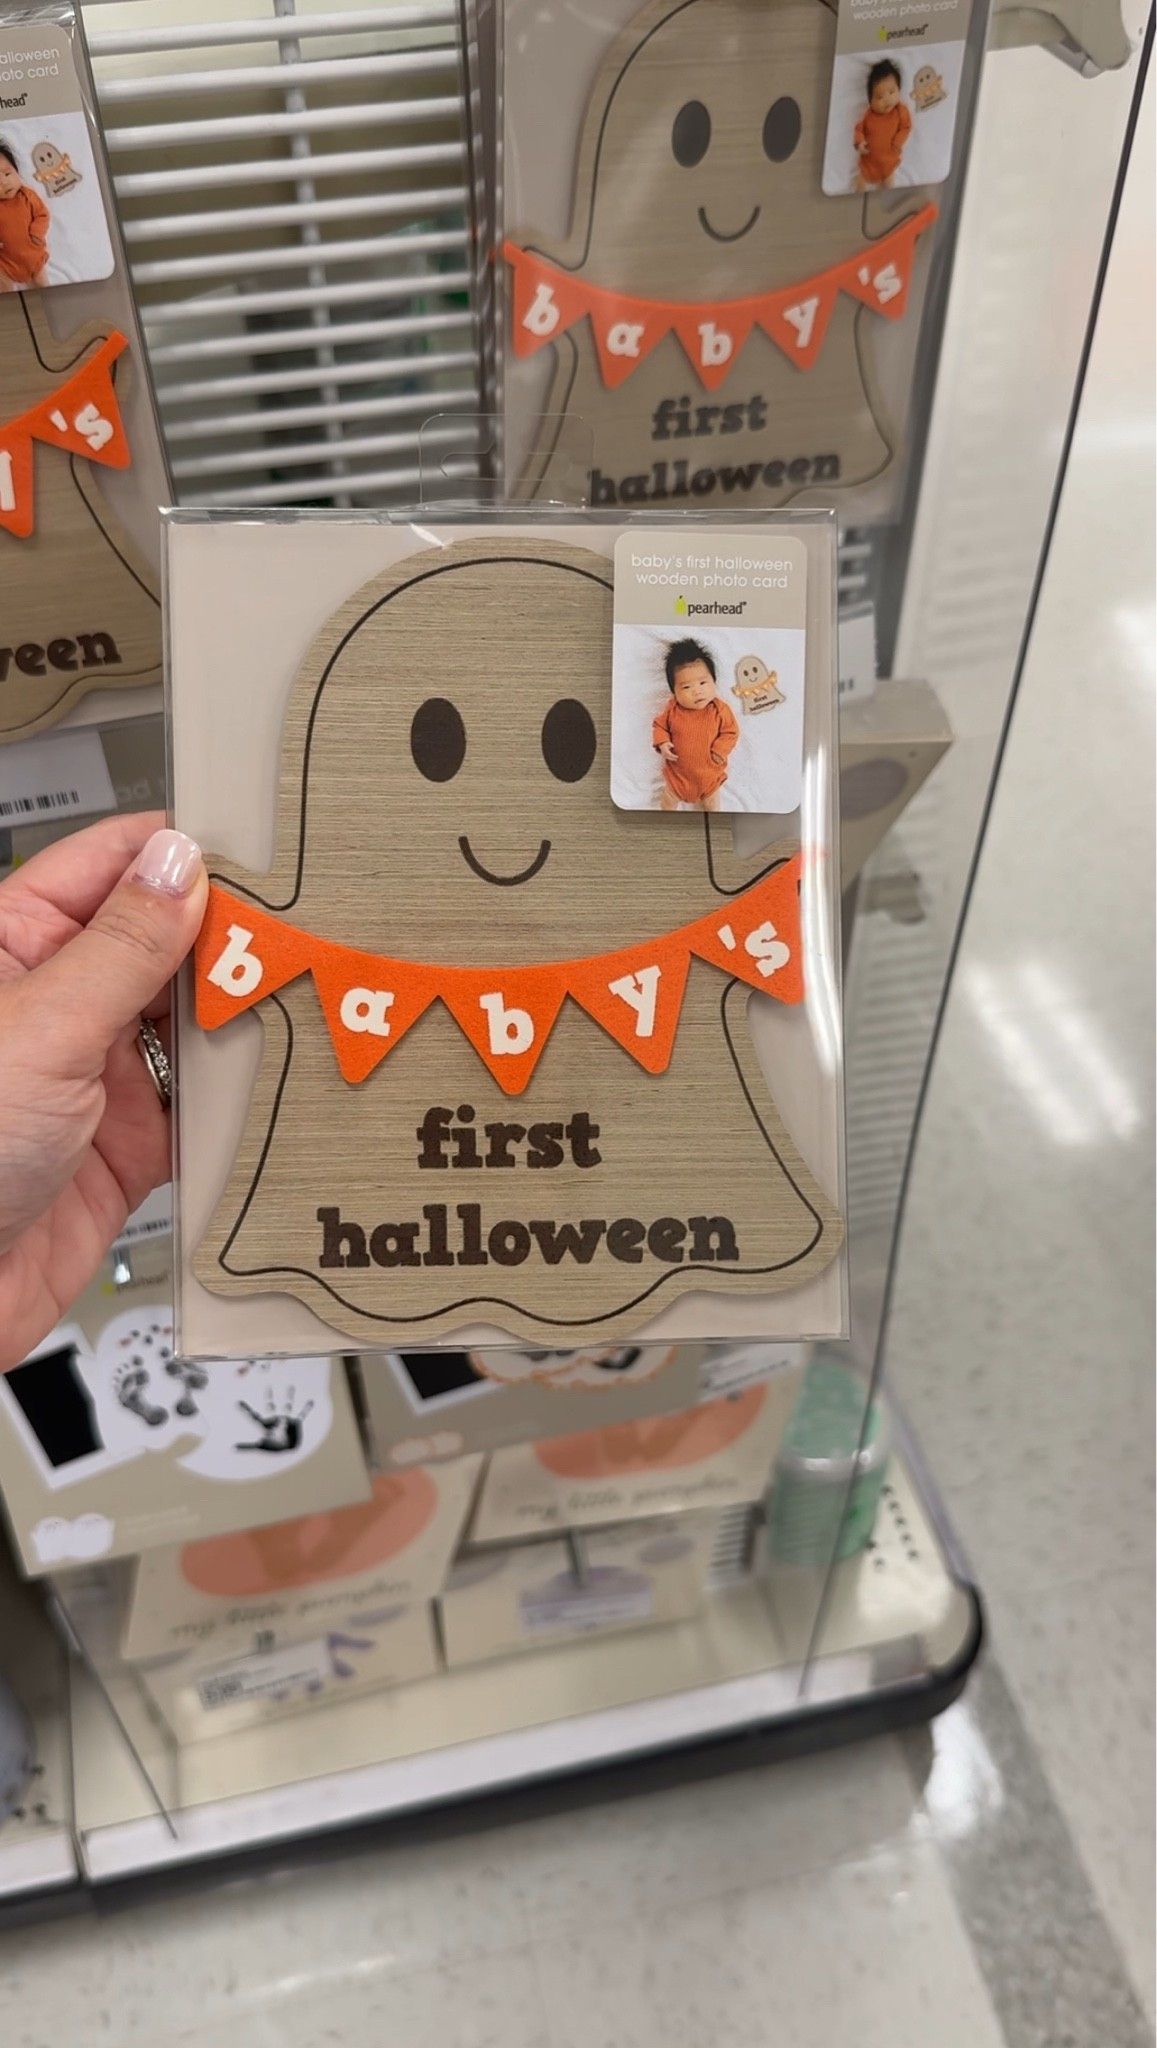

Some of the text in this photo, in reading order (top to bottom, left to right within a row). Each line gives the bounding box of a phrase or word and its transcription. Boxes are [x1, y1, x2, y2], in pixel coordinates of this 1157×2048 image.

[853, 0, 958, 20] wooden photo card
[886, 25, 926, 41] pearhead
[28, 62, 59, 78] card
[522, 264, 902, 367] baby's
[652, 395, 768, 440] first
[588, 454, 840, 506] halloween
[631, 554, 793, 571] baby's first halloween
[636, 573, 788, 588] wooden photo card
[687, 601, 743, 616] pearhead
[207, 921, 791, 1055] baby's
[416, 1104, 602, 1169] first
[317, 1203, 739, 1268] halloween
